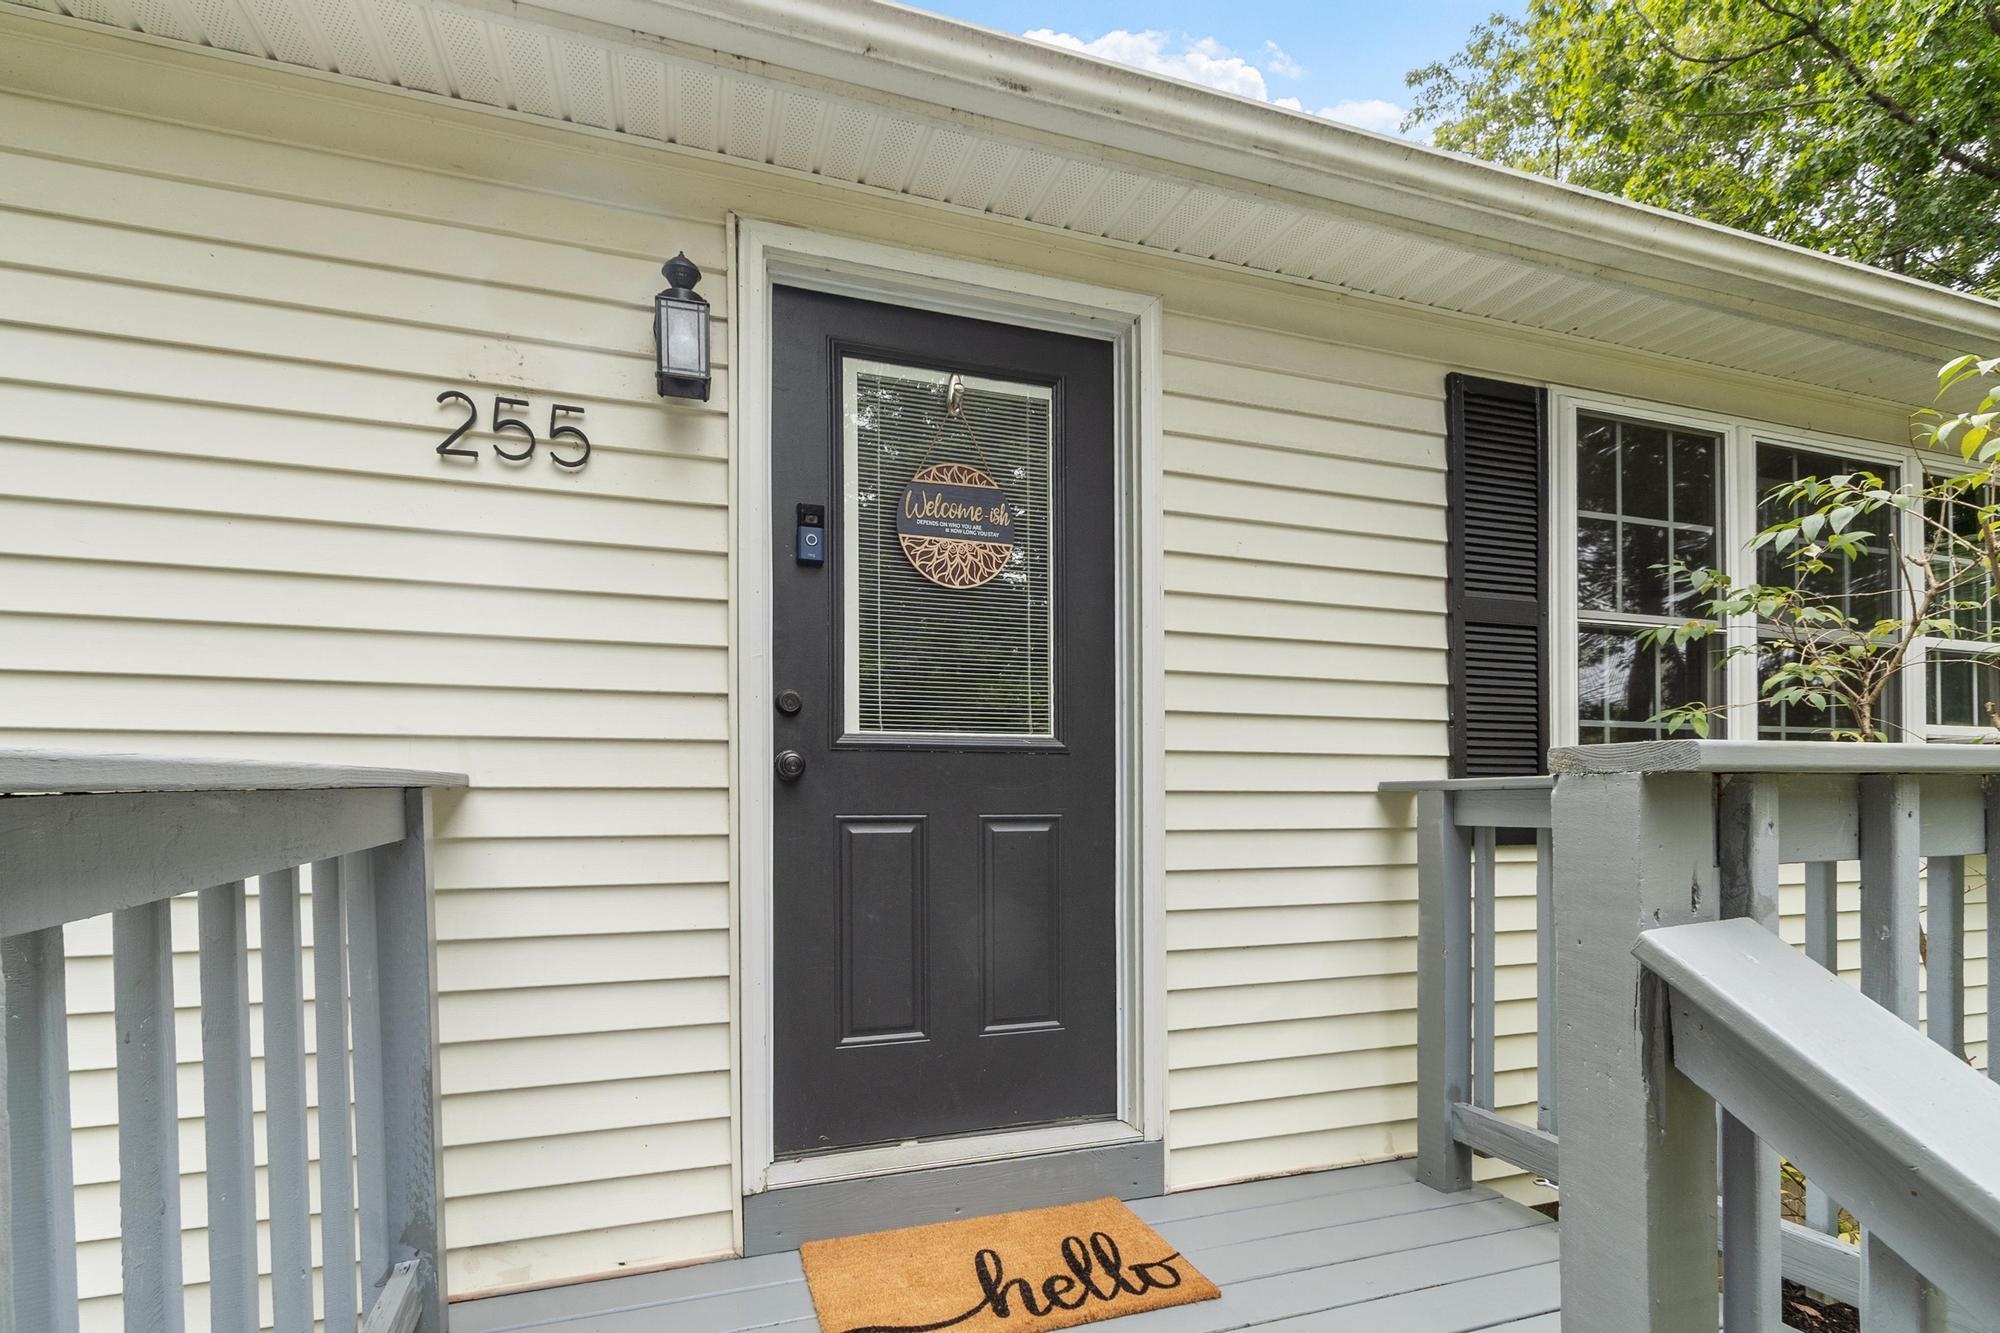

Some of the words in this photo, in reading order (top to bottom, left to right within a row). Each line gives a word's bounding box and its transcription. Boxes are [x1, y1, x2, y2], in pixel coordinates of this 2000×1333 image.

[436, 390, 591, 467] 255
[916, 519, 939, 527] DEPENDS
[968, 1232, 1181, 1319] hello
